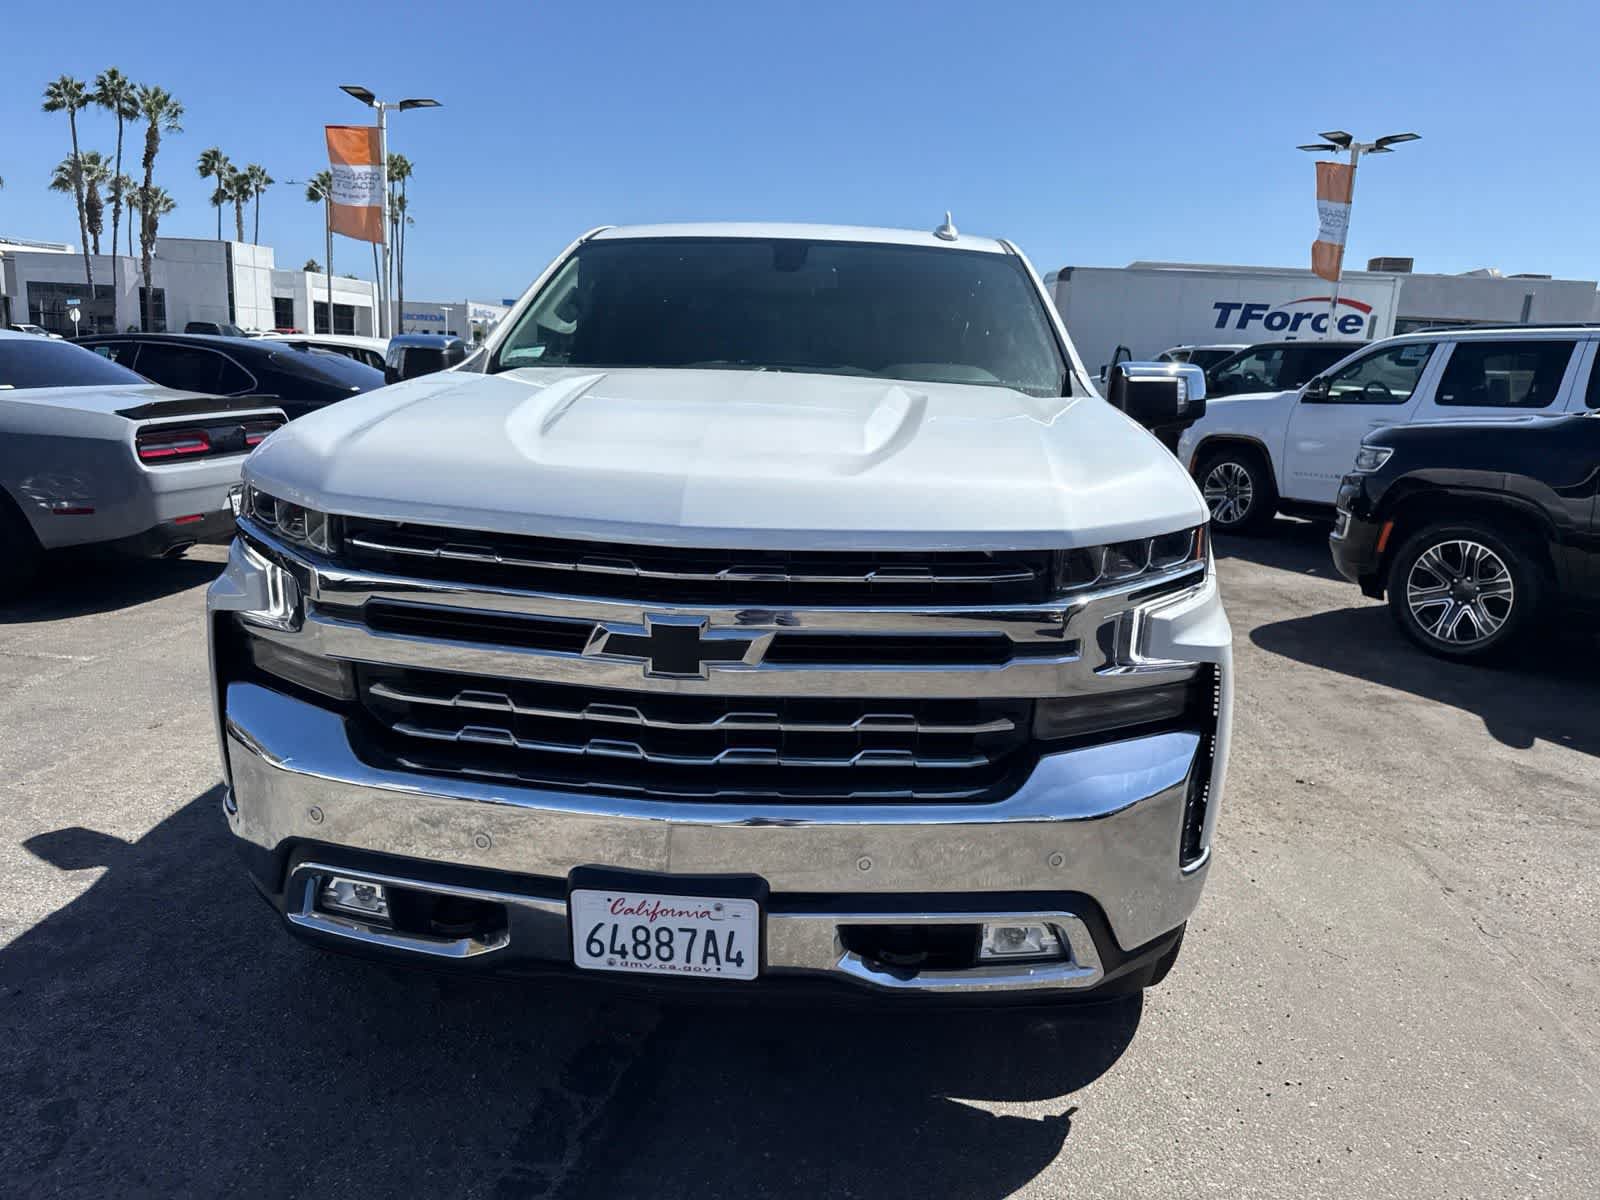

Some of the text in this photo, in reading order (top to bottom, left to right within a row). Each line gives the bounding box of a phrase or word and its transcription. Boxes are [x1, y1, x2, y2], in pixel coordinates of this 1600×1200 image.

[1213, 302, 1364, 334] TForce
[610, 897, 713, 922] California
[586, 921, 744, 968] 64887A4
[620, 960, 712, 972] dmv.ca.gov
